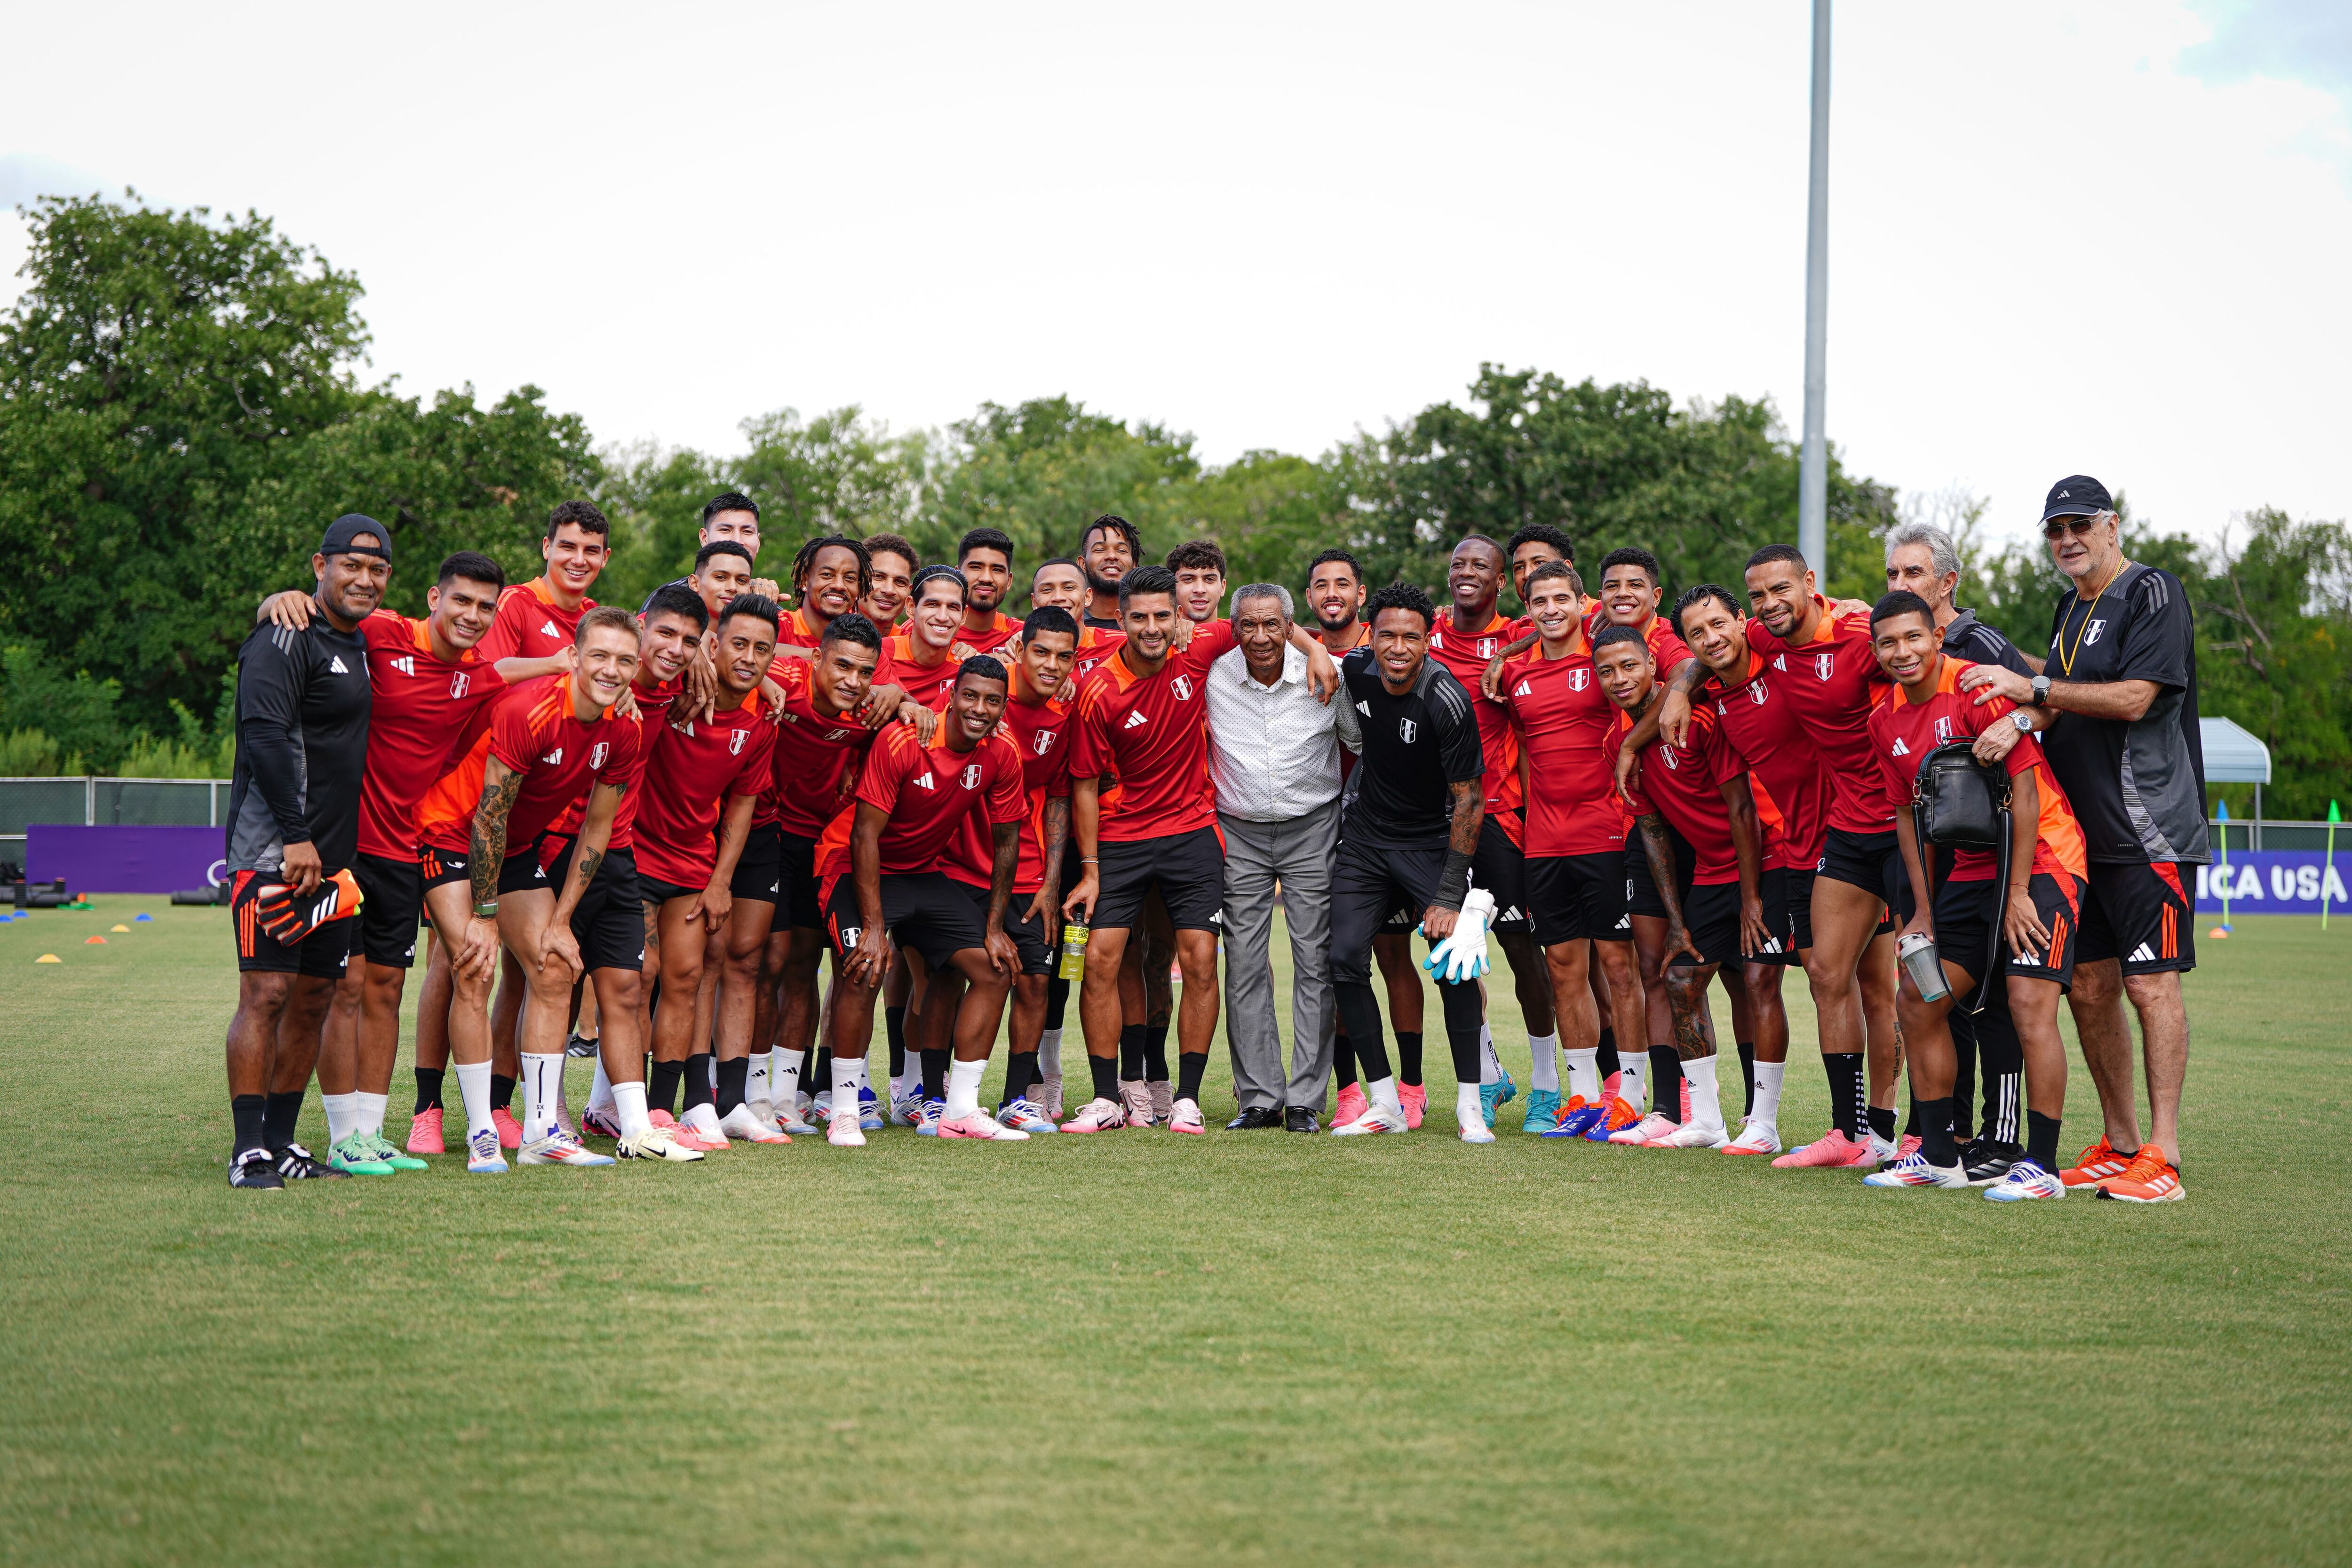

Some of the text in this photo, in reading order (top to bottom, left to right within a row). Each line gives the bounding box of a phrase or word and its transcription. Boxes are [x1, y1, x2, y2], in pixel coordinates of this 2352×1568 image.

[2271, 865, 2348, 903] USA
[1376, 1118, 1397, 1129] F50
[530, 1143, 556, 1154] F50
[2043, 1180, 2060, 1191] F50
